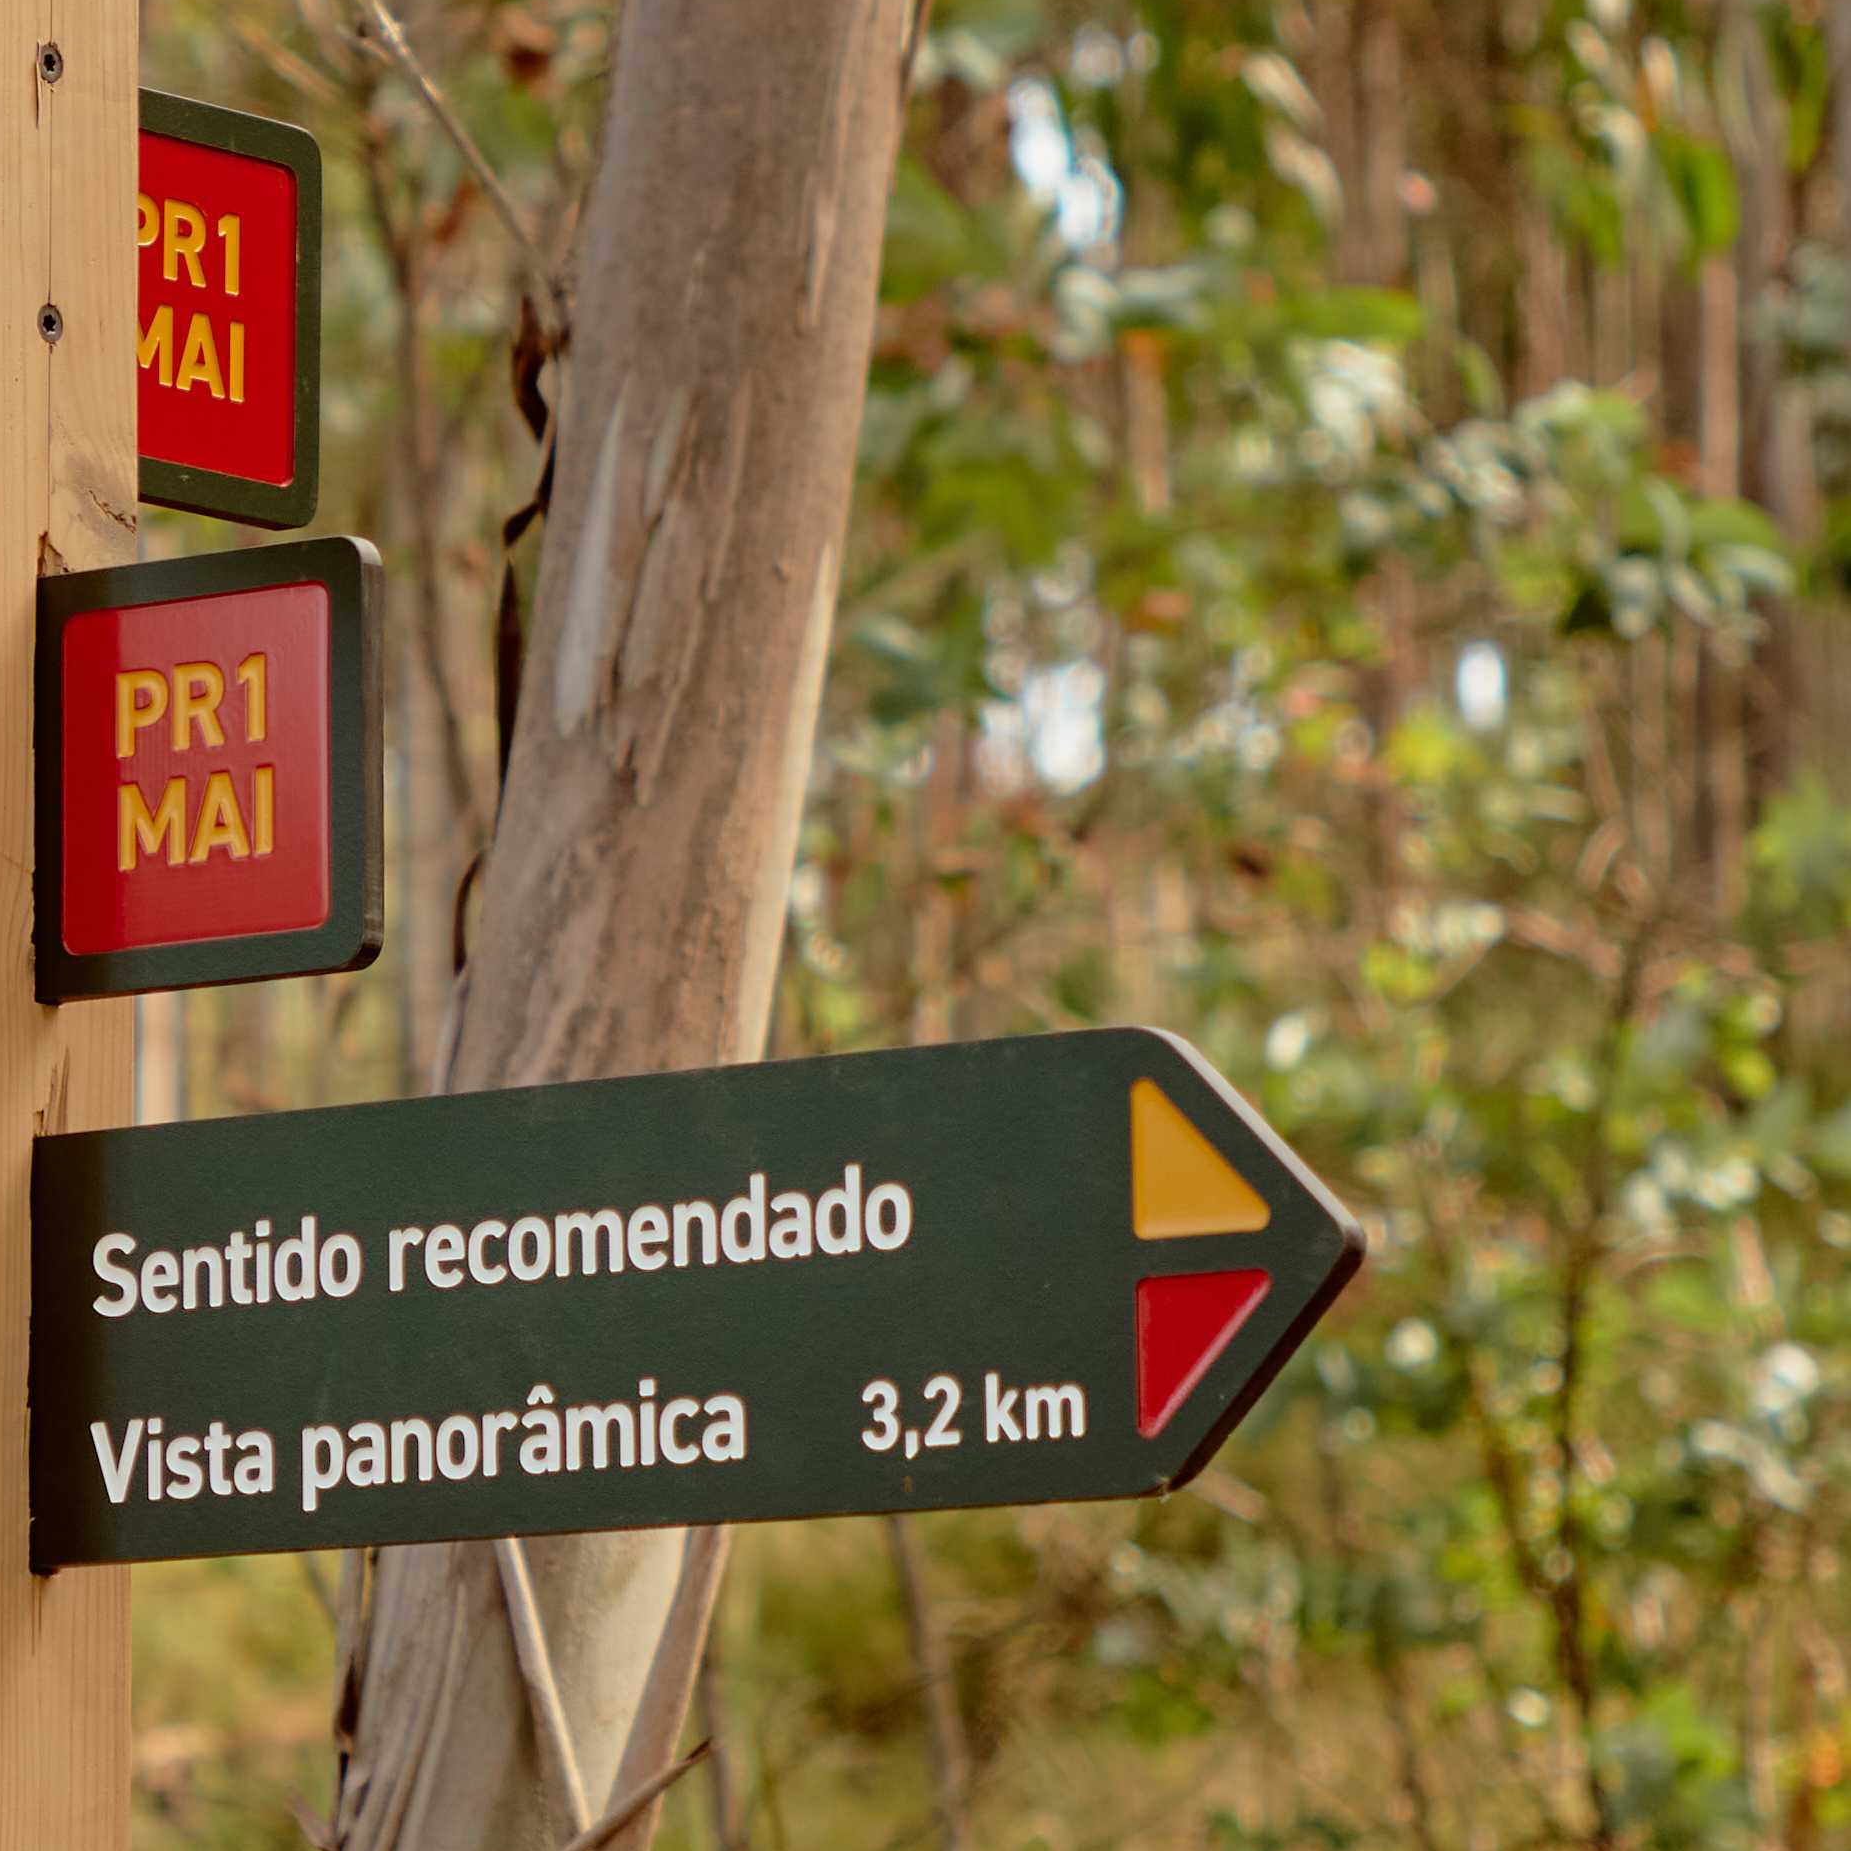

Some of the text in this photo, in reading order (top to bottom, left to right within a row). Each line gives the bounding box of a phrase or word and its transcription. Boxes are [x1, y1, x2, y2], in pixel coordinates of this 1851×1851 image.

[119, 767, 275, 870] MAI
[91, 1163, 913, 1319] Sentido recomendado
[89, 1377, 746, 1514] Vista panorâmica
[860, 1371, 1086, 1461] 3,2 km
